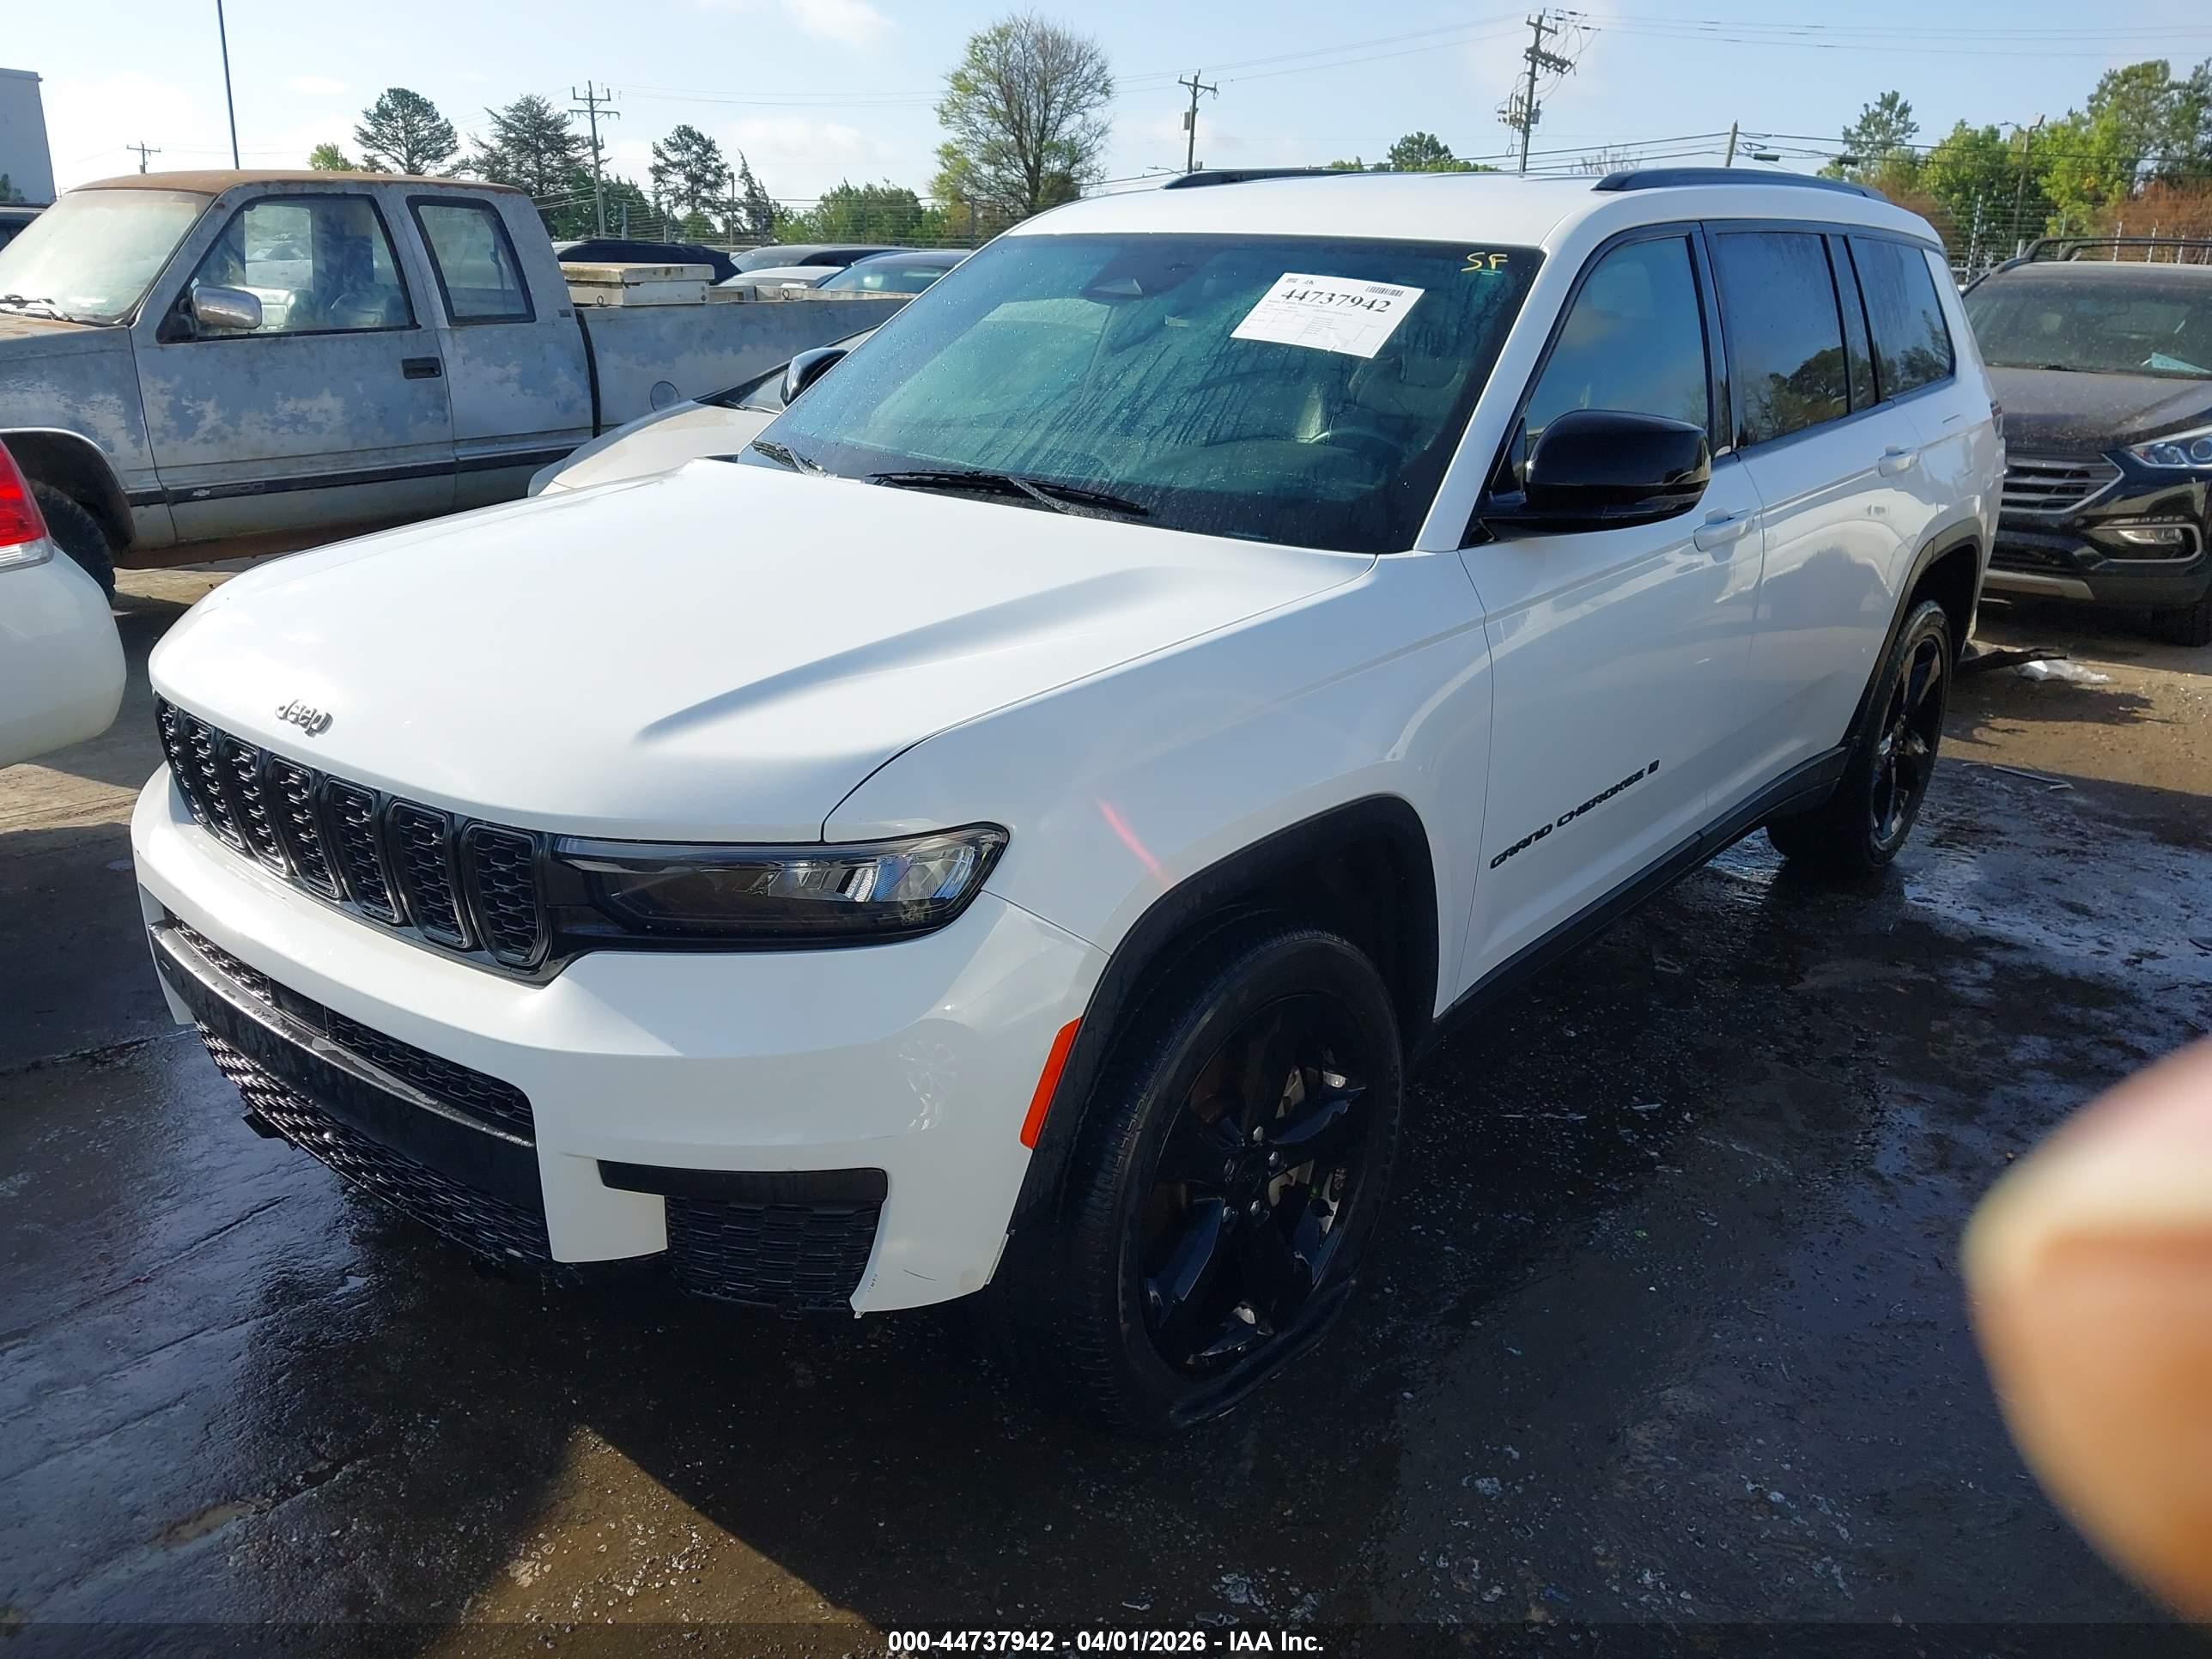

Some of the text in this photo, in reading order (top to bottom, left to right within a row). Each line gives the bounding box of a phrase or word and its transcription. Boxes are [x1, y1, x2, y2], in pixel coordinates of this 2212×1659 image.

[1461, 252, 1509, 271] SF
[1280, 289, 1392, 313] 44737942
[275, 699, 333, 738] Jeep
[1490, 768, 1646, 870] GRAND CHEROKEE
